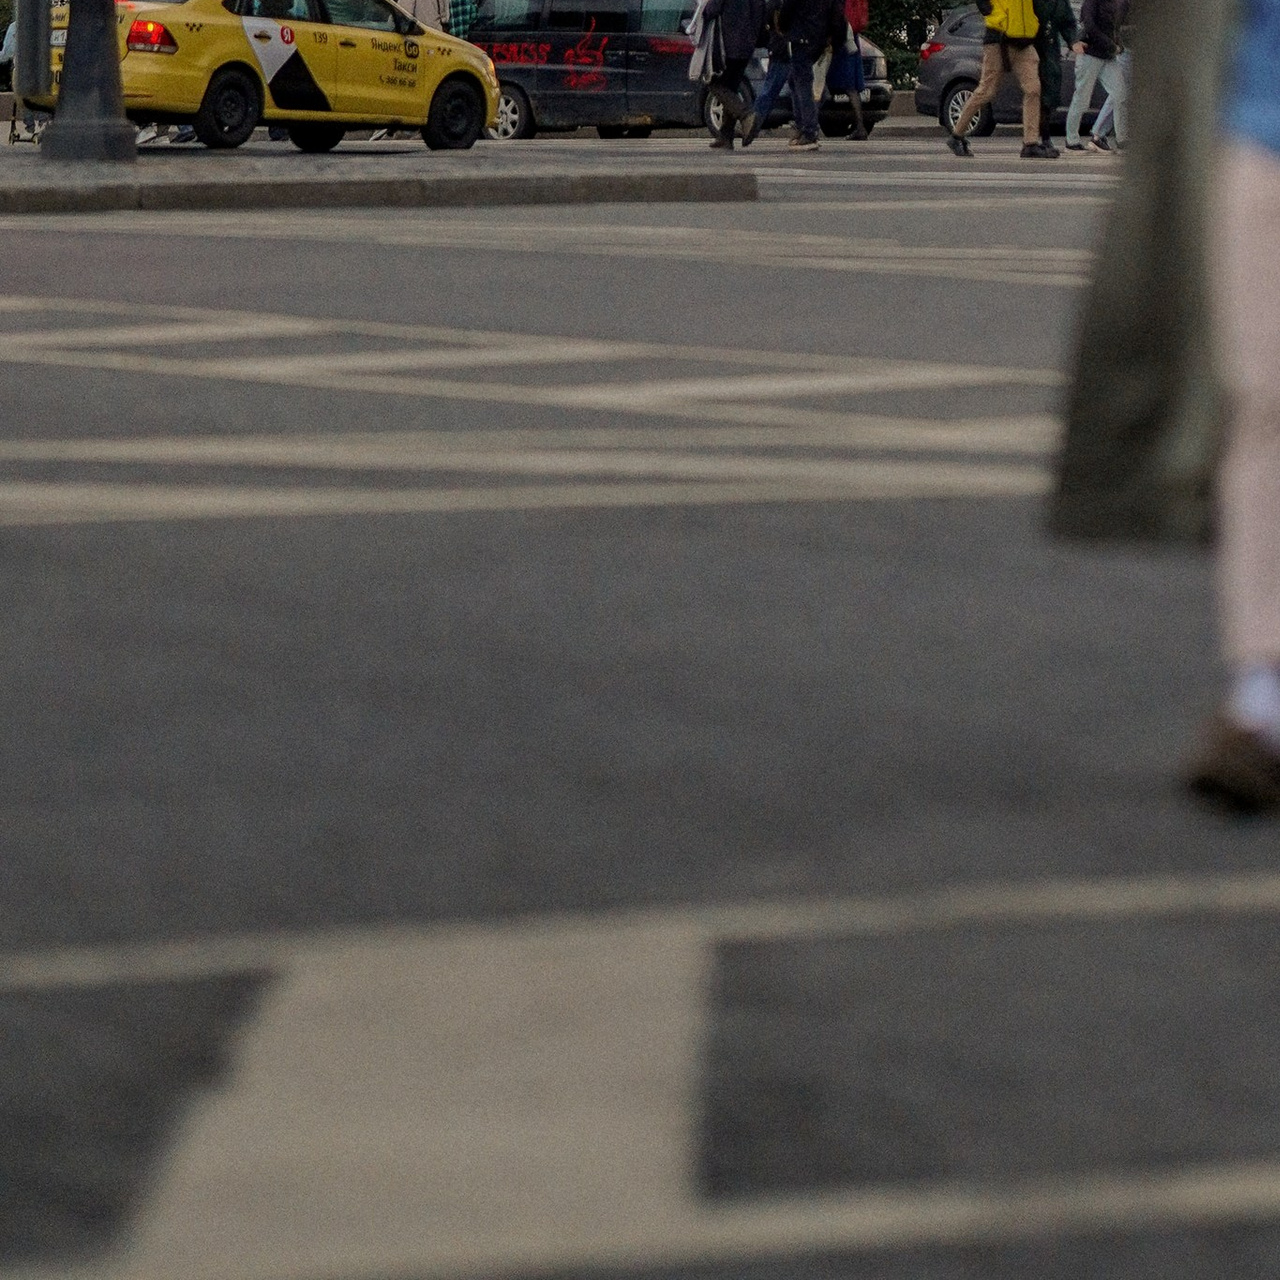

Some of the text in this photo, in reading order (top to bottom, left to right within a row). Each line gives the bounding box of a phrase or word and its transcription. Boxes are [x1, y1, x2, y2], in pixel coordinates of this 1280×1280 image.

[313, 31, 328, 44] 139
[371, 37, 403, 53] Яндекс
[393, 58, 418, 73] Такси
